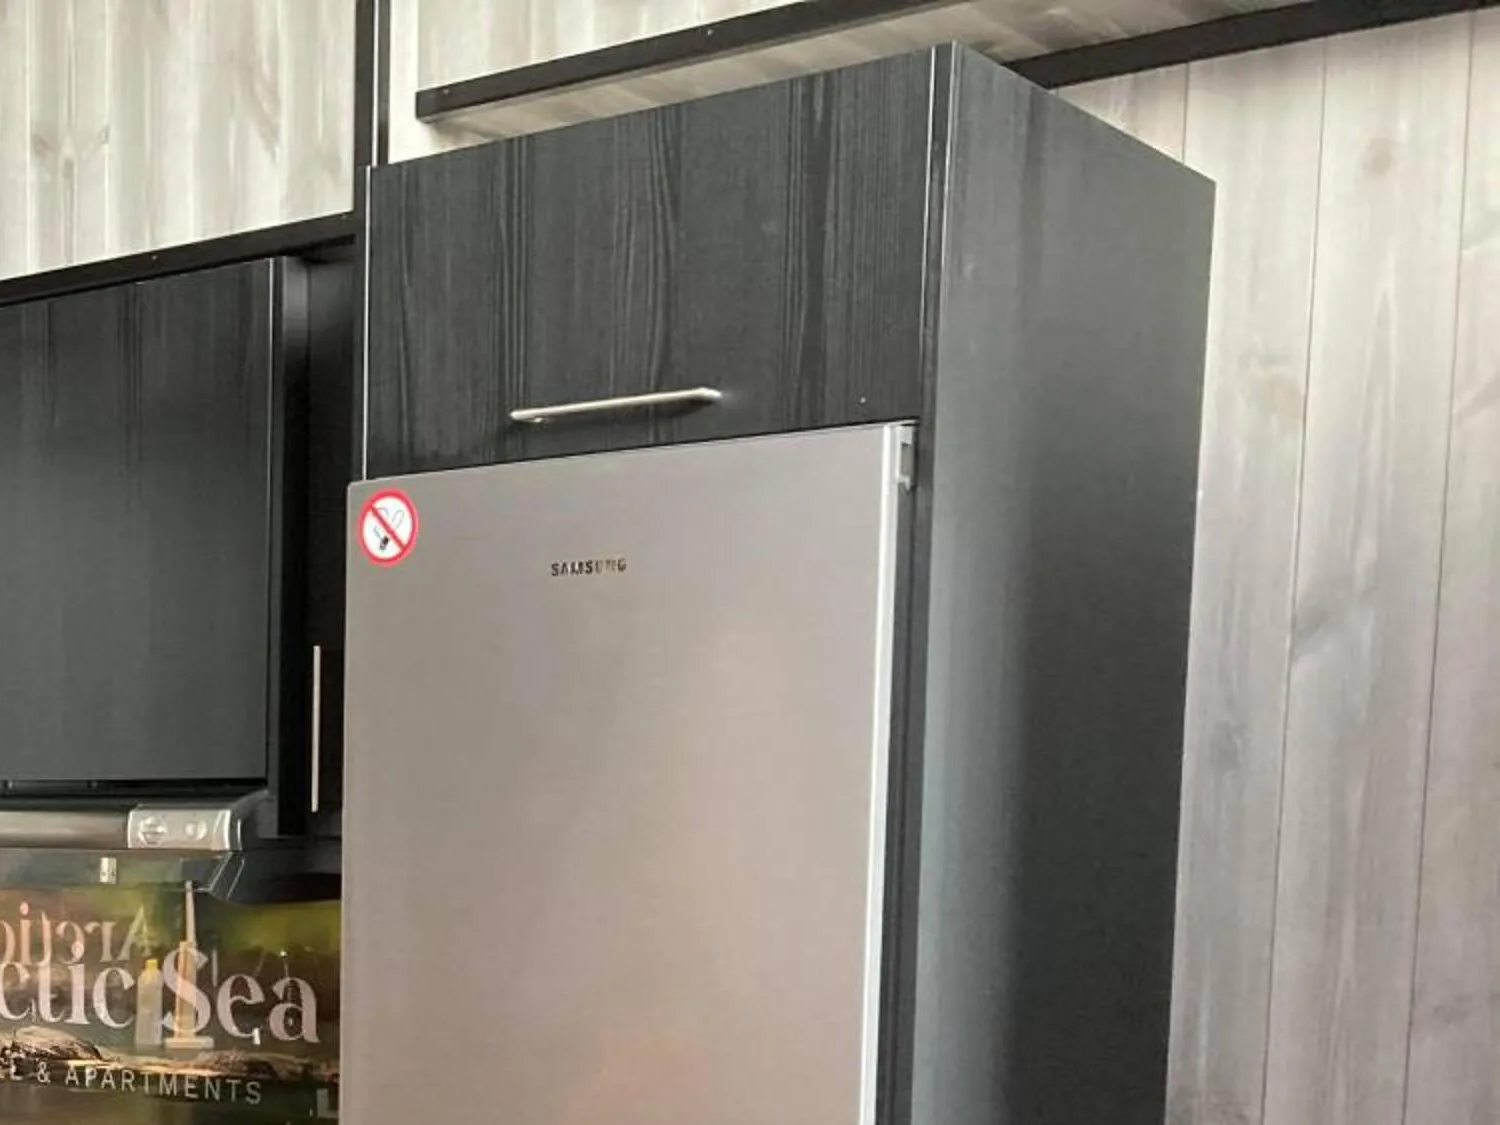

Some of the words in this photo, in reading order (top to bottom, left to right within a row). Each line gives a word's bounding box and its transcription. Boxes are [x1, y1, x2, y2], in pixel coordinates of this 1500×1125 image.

[550, 558, 627, 577] SAMSUNG
[161, 948, 321, 1044] Sea
[37, 1061, 51, 1083] &
[65, 1066, 262, 1105] APARTMENTS
